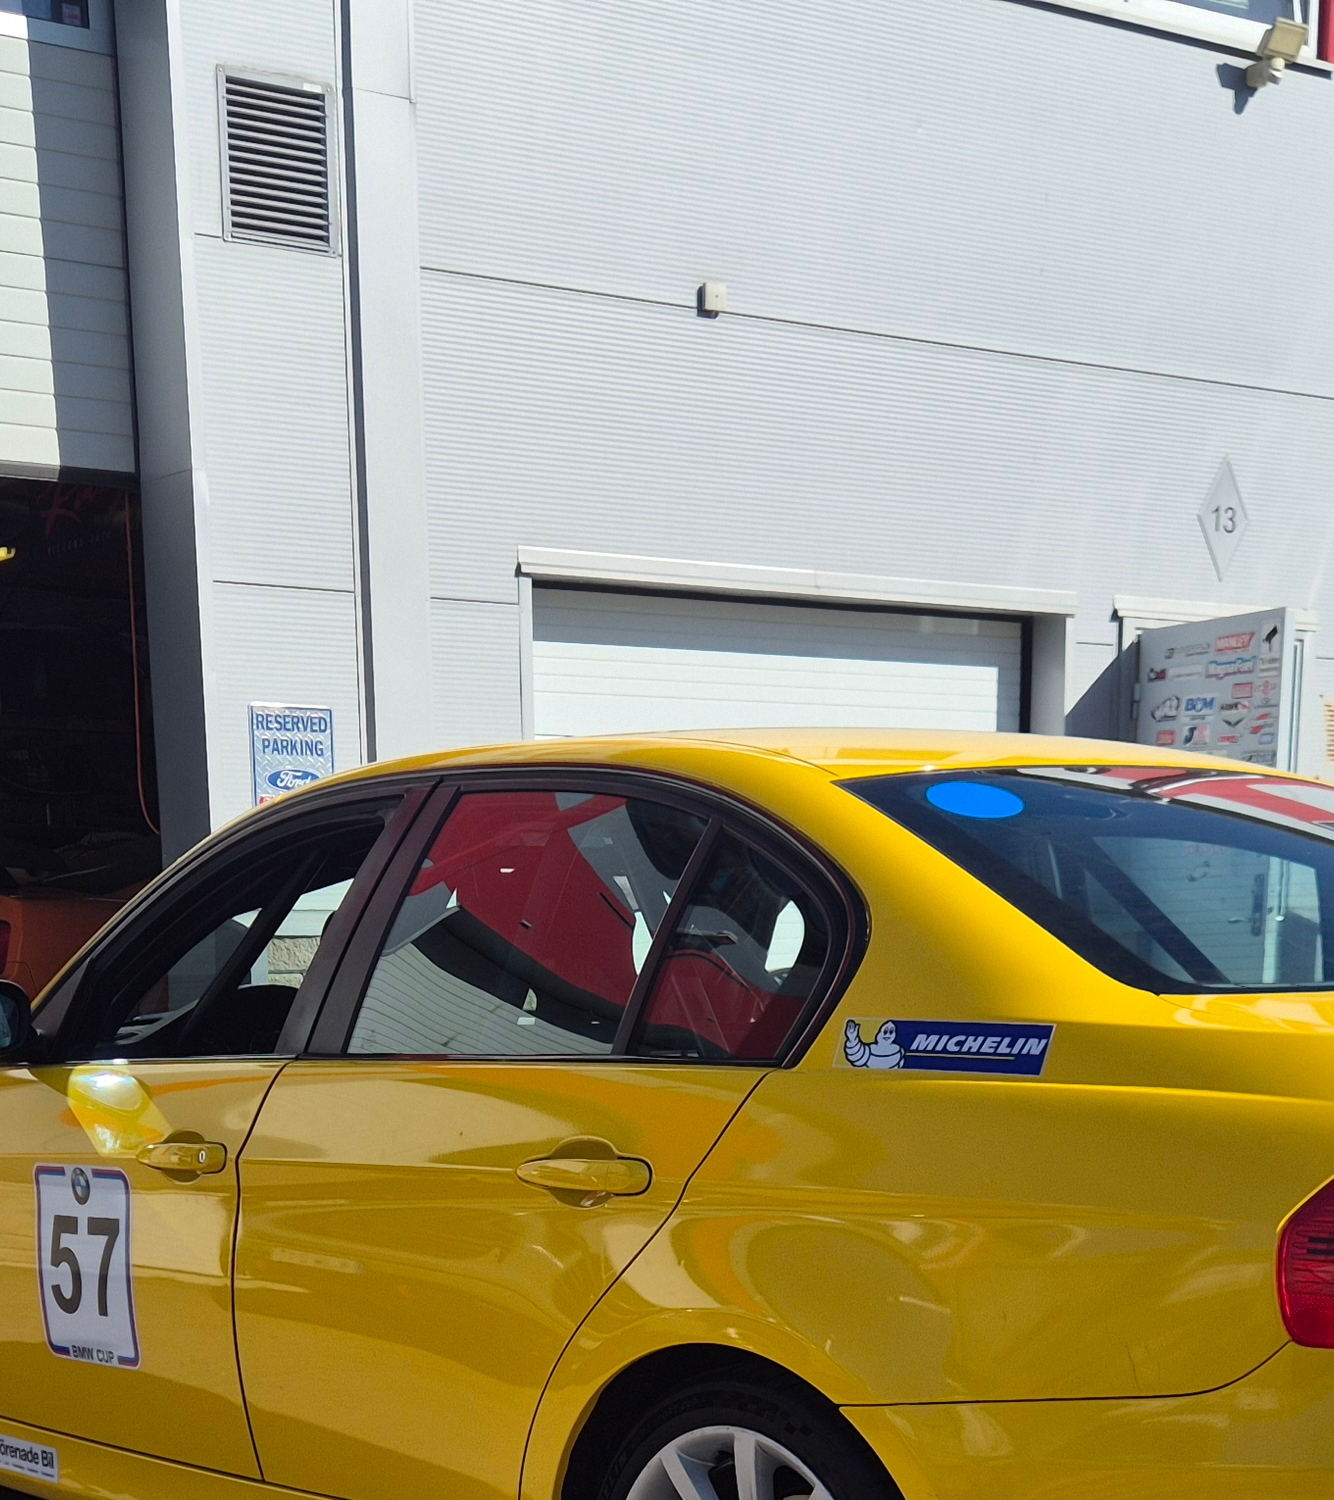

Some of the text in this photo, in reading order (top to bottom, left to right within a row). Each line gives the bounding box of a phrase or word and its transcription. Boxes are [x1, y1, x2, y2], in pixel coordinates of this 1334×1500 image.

[1211, 506, 1236, 533] 13
[255, 714, 328, 733] RESERVED
[262, 738, 324, 757] PARKING
[277, 770, 312, 789] Ford
[910, 1034, 1048, 1056] MICHELIN
[50, 1215, 120, 1317] 57
[71, 1345, 115, 1364] BMW CUP
[41, 1450, 55, 1469] Bil
